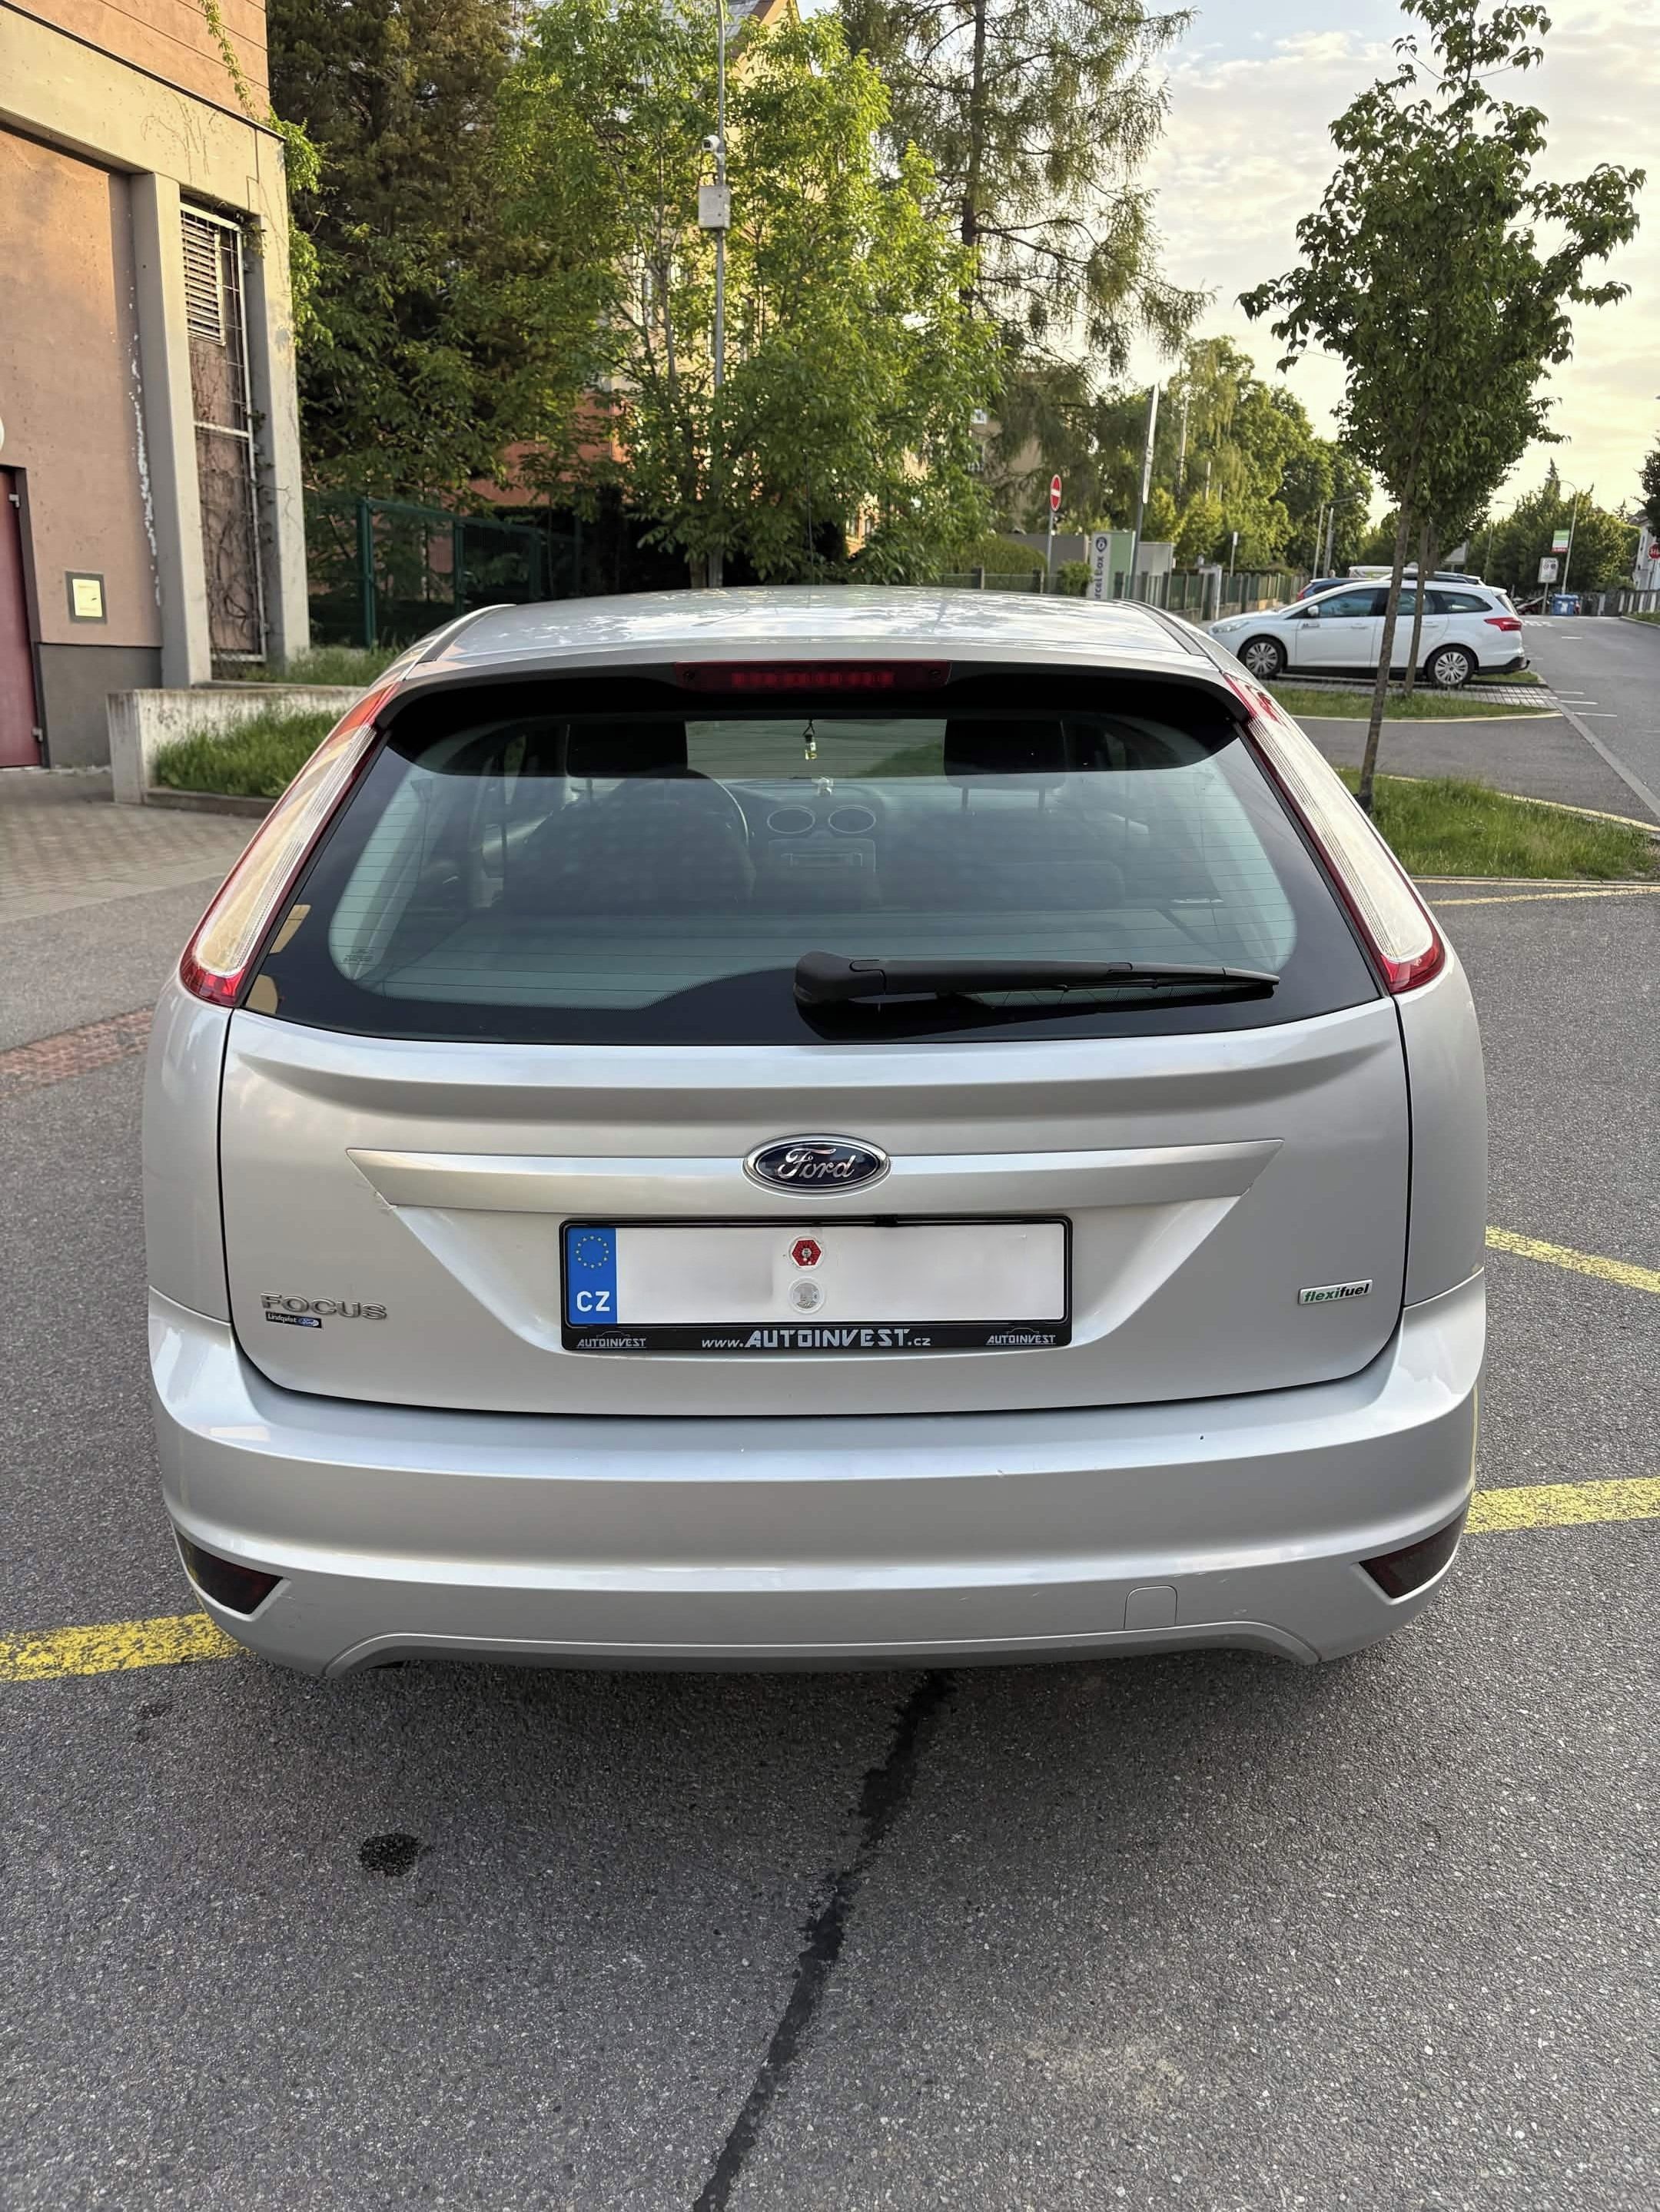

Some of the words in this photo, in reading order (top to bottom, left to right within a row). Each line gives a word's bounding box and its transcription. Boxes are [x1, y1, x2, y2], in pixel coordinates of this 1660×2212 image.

[1094, 578, 1102, 599] rcel
[776, 1147, 856, 1179] Ford
[576, 1291, 610, 1312] CZ
[1303, 1283, 1370, 1302] flexifuel
[261, 1291, 387, 1320] FOCUS
[577, 1338, 646, 1348] AUTOINVEST
[701, 1328, 931, 1348] www.AUTOINVEST.cz
[986, 1335, 1057, 1345] AUTOINVEST
